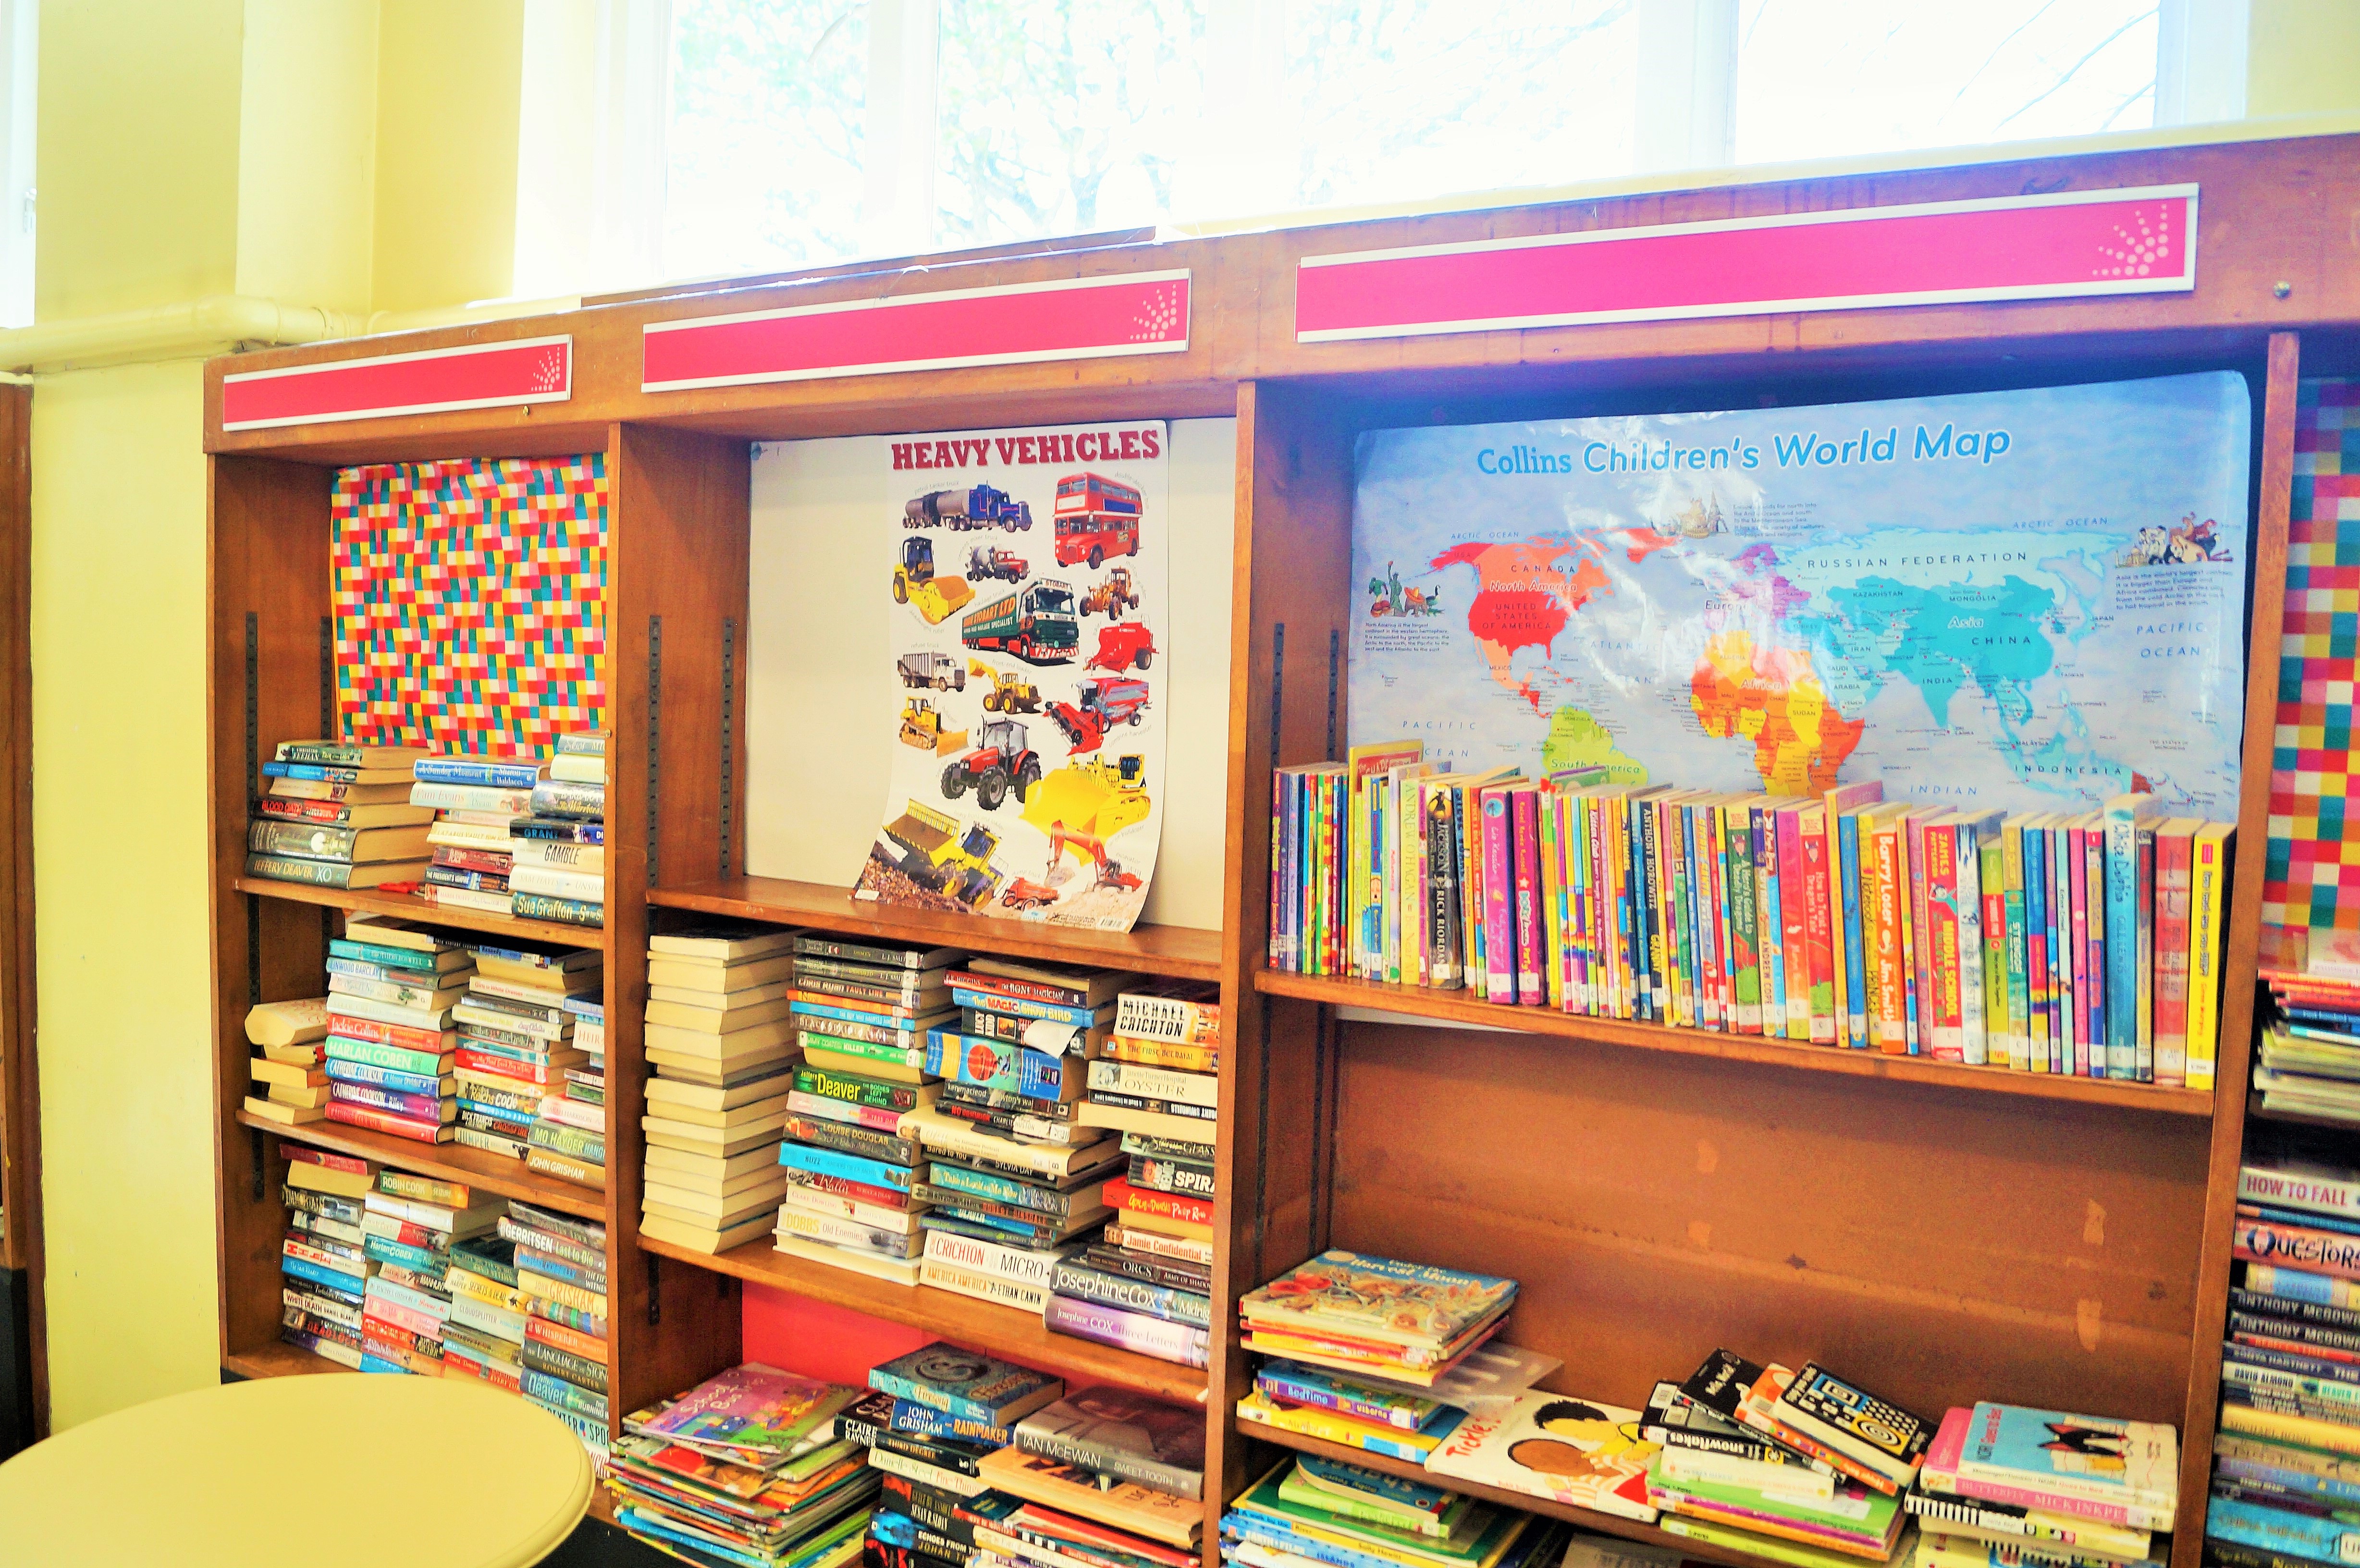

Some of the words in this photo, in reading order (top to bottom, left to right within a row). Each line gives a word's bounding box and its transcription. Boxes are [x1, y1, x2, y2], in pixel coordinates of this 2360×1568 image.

[891, 438, 990, 470] HEAVY
[995, 429, 1161, 466] VEHICLES
[1476, 445, 1572, 476] Collins
[1583, 436, 1759, 473] Children's
[1773, 427, 1897, 468] World
[1912, 422, 2013, 466] Map
[2013, 519, 2055, 529] ARCTIC
[2065, 517, 2108, 527] OCEAN
[1511, 564, 1575, 574] CANADA
[1807, 558, 1888, 569] RUSSIAN
[1901, 551, 2027, 565] FEDERATION
[1045, 579, 1069, 589] STOBART
[1489, 581, 1526, 592] North
[1529, 580, 1578, 592] America
[973, 604, 998, 623] STOBART
[998, 596, 1016, 617] LTD
[1496, 602, 1536, 611] UNITED
[1947, 616, 1984, 629] Asia
[2137, 622, 2206, 635] PACIFIC
[1972, 636, 2031, 645] CHINA
[2140, 646, 2200, 658] OCEAN
[1740, 679, 1781, 691] Africa
[1402, 721, 1477, 730] PACIFIC
[454, 768, 481, 777] Moment
[1551, 759, 1587, 769] South
[2015, 764, 2123, 775] INDONESIA
[416, 789, 437, 799] Pam
[439, 790, 465, 802] Evans
[1910, 785, 1977, 796] INDIAN
[1404, 784, 1416, 845] ANDREW
[1589, 809, 1598, 837] Kitten
[1643, 808, 1654, 855] ANTHONY
[1696, 817, 1708, 858] SECRET
[544, 844, 581, 865] GAMBLE
[1437, 825, 1450, 872] JACKSON
[1879, 836, 1895, 882] Barry
[1930, 831, 1939, 878] PATTERSON
[1939, 833, 1950, 876] JAMES
[283, 863, 312, 878] DEAVER
[315, 867, 332, 882] XO
[1404, 845, 1418, 903] O'HAGAN
[1645, 858, 1657, 909] HOROWITZ
[1698, 862, 1710, 897] SANTA
[1816, 871, 1825, 890] How
[517, 896, 535, 914] Sue
[537, 898, 573, 920] Grafton
[1437, 890, 1445, 923] RICK
[1743, 897, 1754, 922] Guide
[1880, 885, 1894, 926] Loser
[1809, 914, 1818, 933] Tale
[1649, 933, 1662, 973] GRANNY
[1942, 920, 1955, 968] MIDDLE
[330, 961, 354, 972] LINWOOD
[356, 964, 380, 976] BARCLAY
[1761, 941, 1771, 980] ANDREW
[1880, 959, 1893, 982] Jim
[1881, 985, 1895, 1021] Smith
[1944, 969, 1958, 1018] SCHOOL
[972, 996, 984, 1007] The
[986, 997, 1019, 1013] MAGIC
[1020, 1003, 1046, 1017] SNOW
[1048, 1008, 1072, 1023] BIRD
[1123, 999, 1185, 1021] MICHAEL
[330, 1018, 353, 1036] Jackie
[354, 1024, 380, 1038] Collins
[1120, 1016, 1183, 1037] CRICHTON
[329, 1041, 370, 1062] HARLAN
[372, 1050, 412, 1069] COBEN
[843, 1044, 864, 1054] KILLER
[817, 1072, 860, 1101] Deaver
[1125, 1080, 1185, 1097] OYSTER
[389, 1096, 404, 1112] Riley
[495, 1092, 518, 1109] code
[462, 1111, 473, 1122] DICK
[534, 1128, 548, 1141] MO
[550, 1133, 584, 1153] HAYDER
[852, 1129, 889, 1145] DOUGLAS
[529, 1155, 550, 1170] JOHN
[551, 1161, 585, 1181] GRISHAM
[805, 1155, 822, 1166] BUZZ
[995, 1160, 1018, 1174] SYLVIA
[1020, 1165, 1033, 1176] DAY
[383, 1176, 405, 1191] ROBIN
[406, 1181, 426, 1194] COOK
[2246, 1176, 2285, 1196] HOW
[2286, 1181, 2307, 1200] TO
[2311, 1185, 2349, 1207] FALL
[786, 1213, 819, 1234] DOBBS
[823, 1224, 834, 1235] Old
[835, 1228, 863, 1242] Enemies
[505, 1225, 553, 1253] GERRITSEN
[1127, 1233, 1151, 1250] Jamie
[1154, 1240, 1201, 1261] Confidential
[935, 1236, 985, 1266] CRICHTON
[1000, 1254, 1044, 1280] MICRO
[1123, 1262, 1152, 1278] ORCS
[550, 1282, 595, 1311] GRISHAM
[927, 1266, 956, 1284] AMERICA
[958, 1274, 987, 1293] AMERICA
[998, 1283, 1018, 1299] ETHAN
[1020, 1288, 1041, 1306] CANIN
[1053, 1267, 1128, 1300] Josephine
[1128, 1285, 1157, 1308] Cox
[286, 1293, 302, 1306] WHITE
[305, 1300, 322, 1313] DEATH
[459, 1304, 497, 1323] CLOUDSPLITTER
[2237, 1294, 2299, 1312] ANTHONY
[534, 1323, 578, 1346] WHISPERER
[1057, 1308, 1088, 1324] Josephine
[1090, 1317, 1114, 1334] COX
[1119, 1323, 1144, 1341] Three
[1147, 1330, 1178, 1349] Letters
[2239, 1315, 2299, 1338] ANTHONY
[572, 1372, 600, 1389] CARTER
[2234, 1367, 2257, 1381] DAVID
[2260, 1372, 2294, 1388] ALMOND
[528, 1372, 565, 1406] Deaver
[908, 1406, 934, 1421] JOHN
[845, 1419, 878, 1437] CLAIRE
[845, 1430, 876, 1448] RAYNER
[898, 1417, 943, 1435] GRISHAM
[954, 1418, 1008, 1445] RAINMAKER
[1023, 1434, 1043, 1453] IAN
[1046, 1439, 1101, 1469] McEWAN
[1670, 1432, 1744, 1455] snowflakes
[1145, 1471, 1173, 1486] TOOTH
[2034, 1492, 2071, 1511] MICK
[918, 1531, 945, 1546] ECHOES
[946, 1538, 967, 1553] FROM
[918, 1542, 950, 1558] JOHAN
